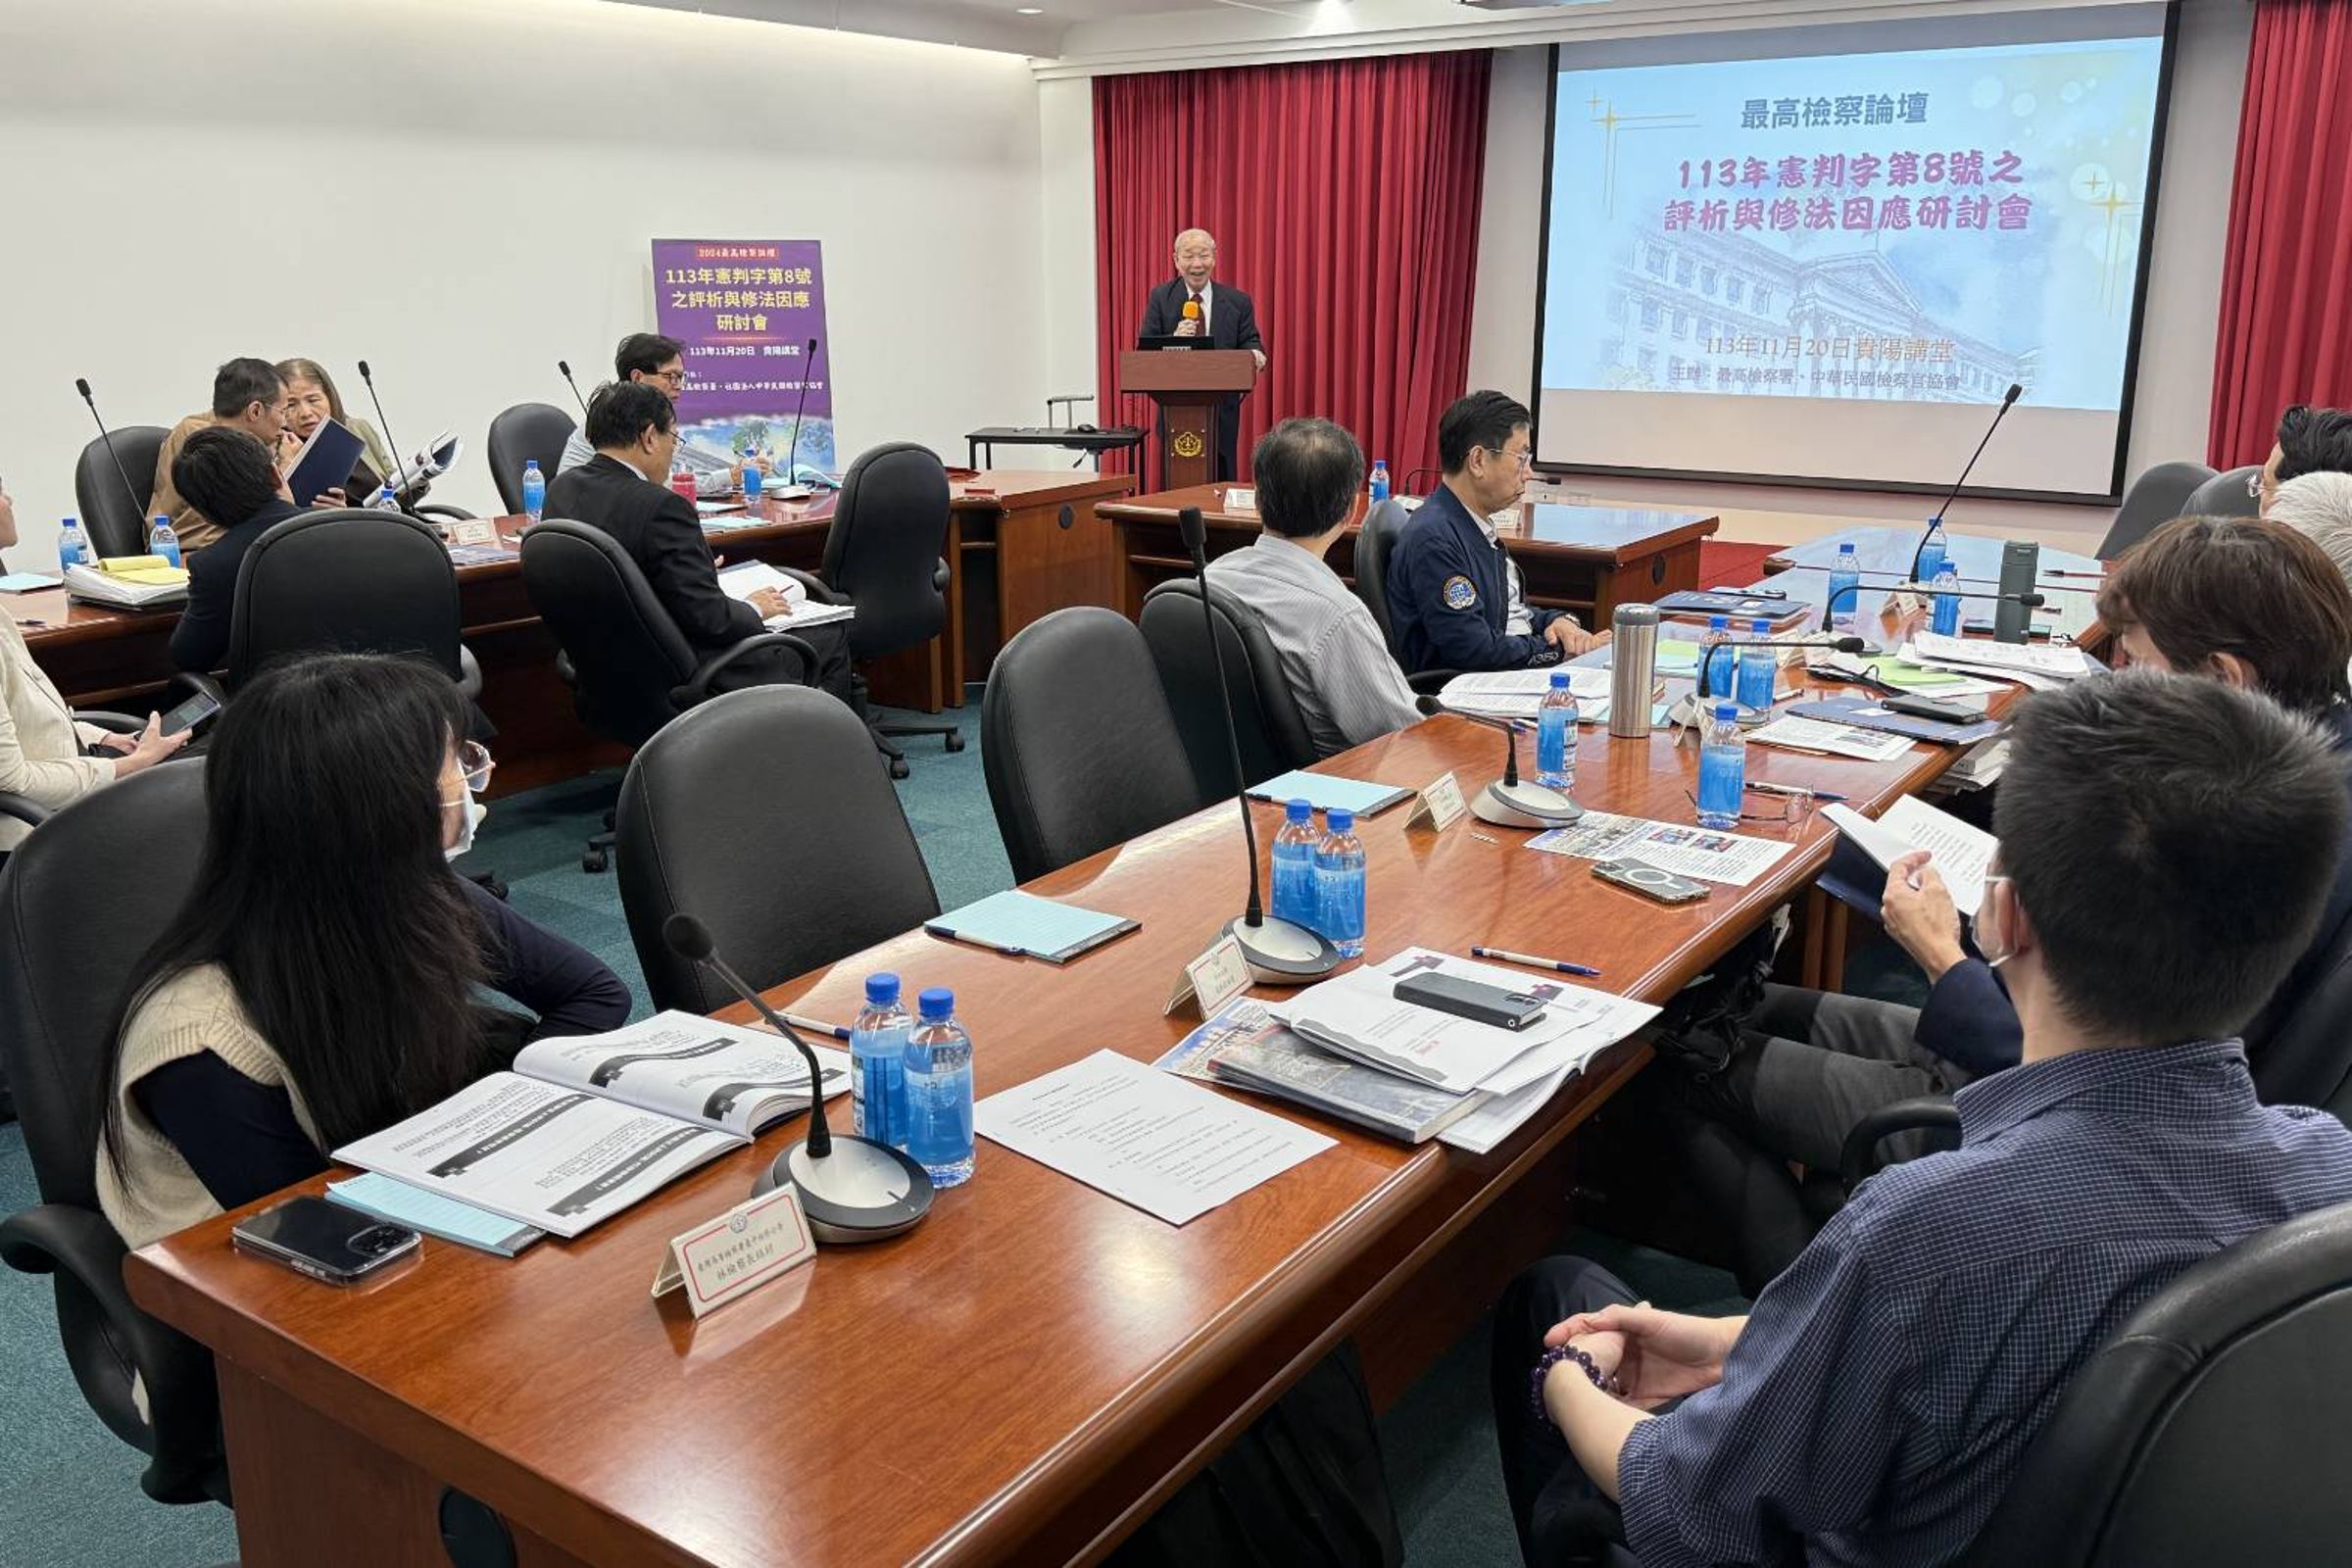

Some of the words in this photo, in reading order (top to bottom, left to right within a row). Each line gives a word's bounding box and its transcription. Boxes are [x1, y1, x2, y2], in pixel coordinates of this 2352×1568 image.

[1740, 92, 1930, 129] 最高檢察論壇
[1679, 150, 2024, 190] 113年憲判字第8號之
[1664, 193, 2034, 232] 評析與修法因應研討會
[666, 268, 812, 285] 113年憲判字第8號
[673, 291, 810, 309] 之評析與修法因應
[716, 314, 768, 331] 研討會
